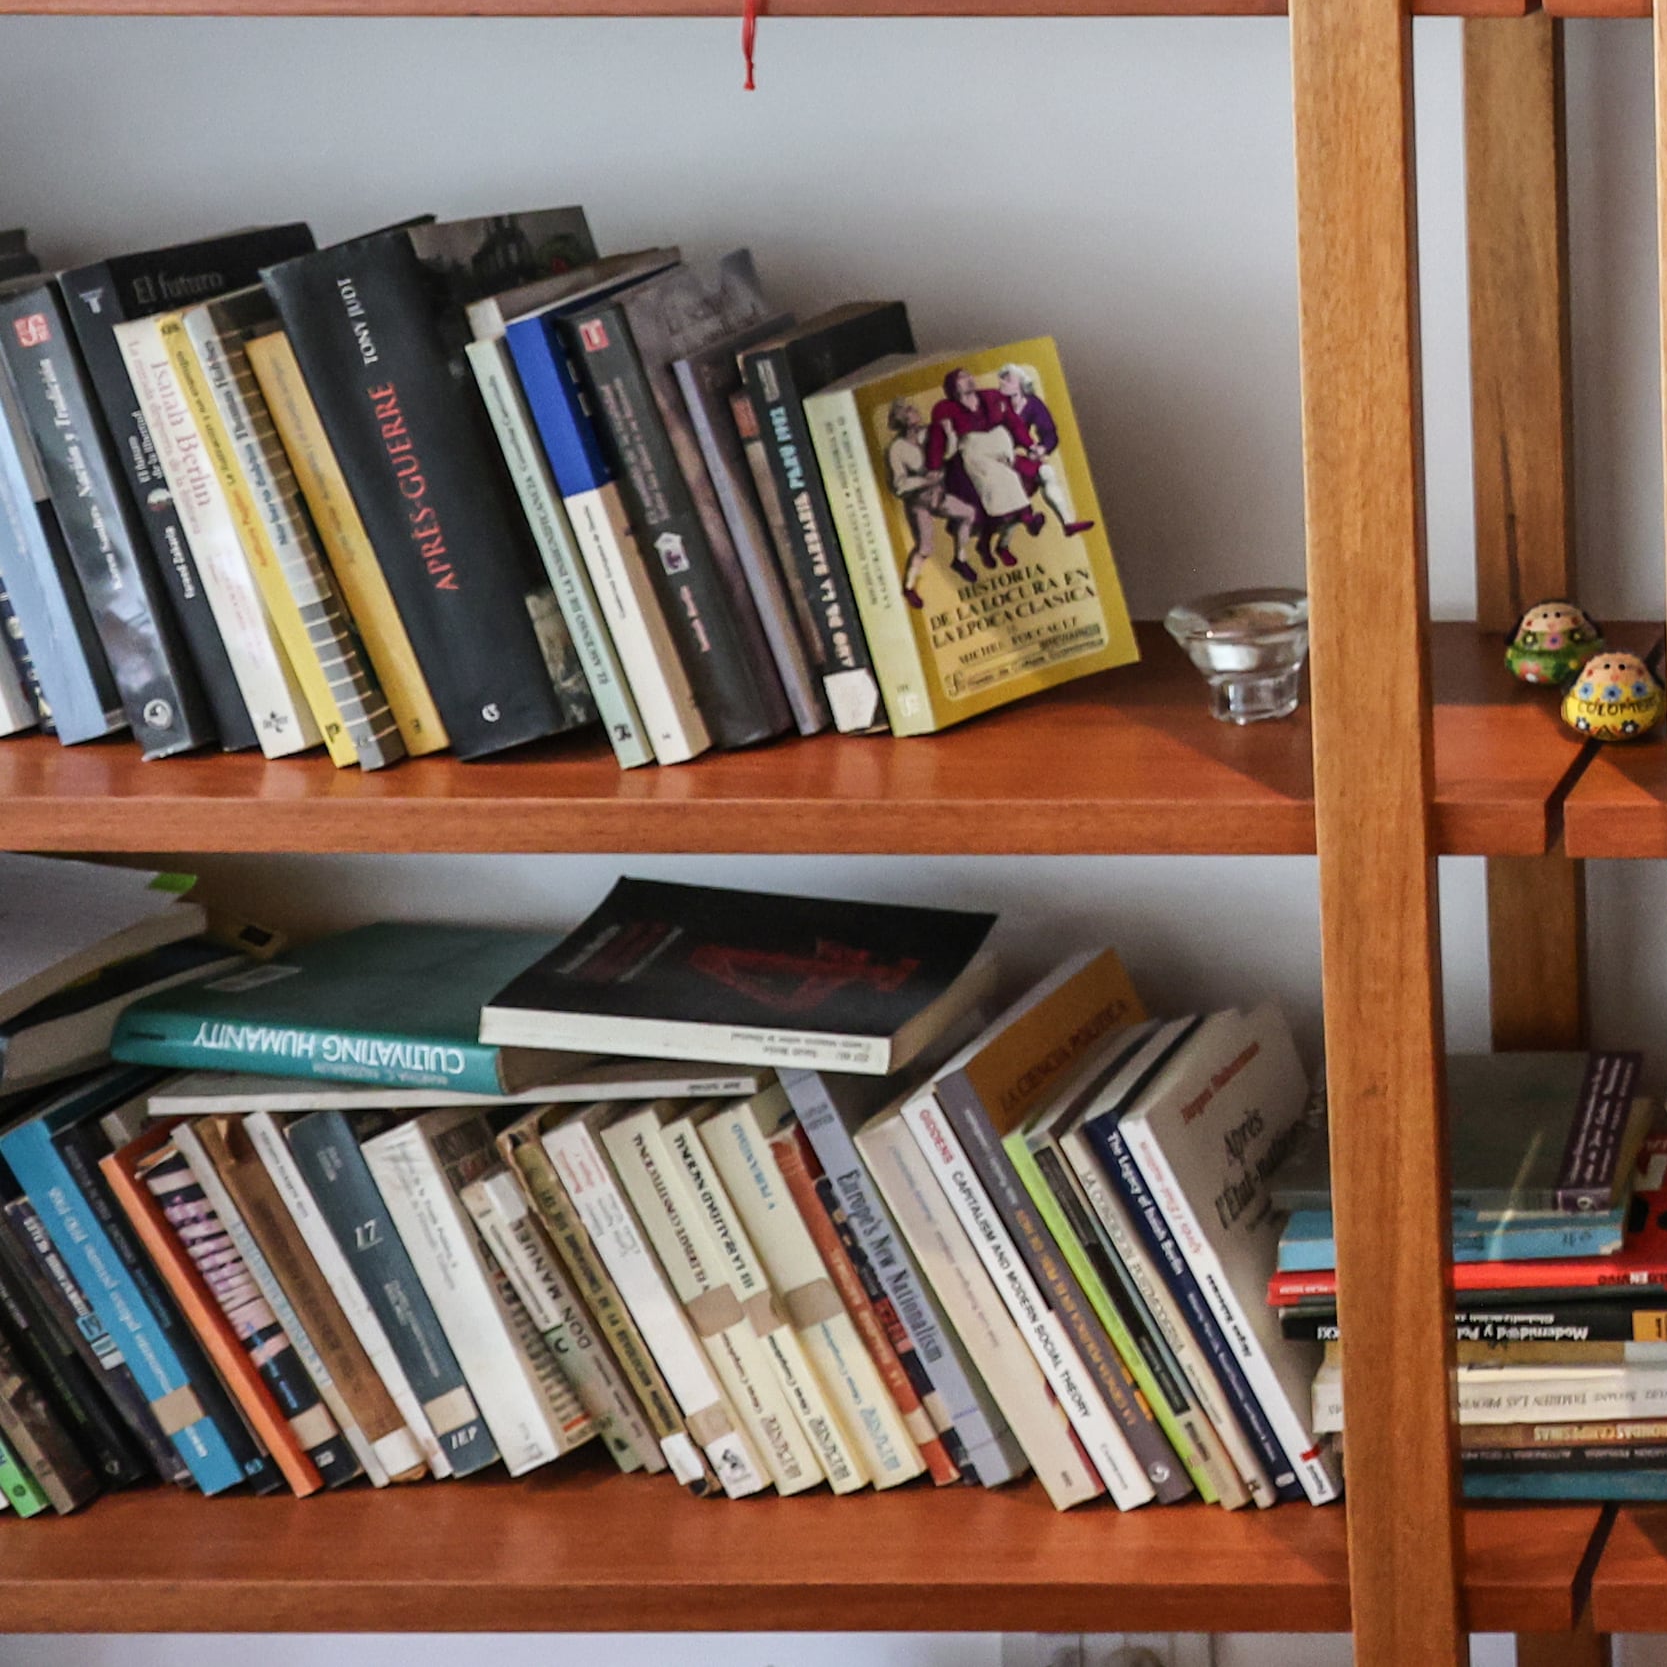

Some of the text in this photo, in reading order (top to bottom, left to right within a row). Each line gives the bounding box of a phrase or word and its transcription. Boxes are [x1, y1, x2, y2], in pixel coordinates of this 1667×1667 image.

[334, 275, 380, 366] TONY JUDT
[148, 357, 219, 509] Isaiah Berlin
[363, 379, 460, 597] APRÈS-GUERRE
[928, 566, 1090, 631] DE LA LOCURA EN
[957, 561, 1046, 603] HISTORIA
[193, 1021, 466, 1074] CULTIVATING HUMANITY
[1105, 1131, 1184, 1275] The Legacy of Isaiah Berlin
[509, 1219, 593, 1350] DON MANUEL
[830, 1167, 946, 1364] Europe's New Nationalism
[951, 1169, 1090, 1419] CAPITALISM AND MODERN SOCIAL THEORY
[1457, 1325, 1479, 1339] Pol
[1484, 1324, 1493, 1337] y
